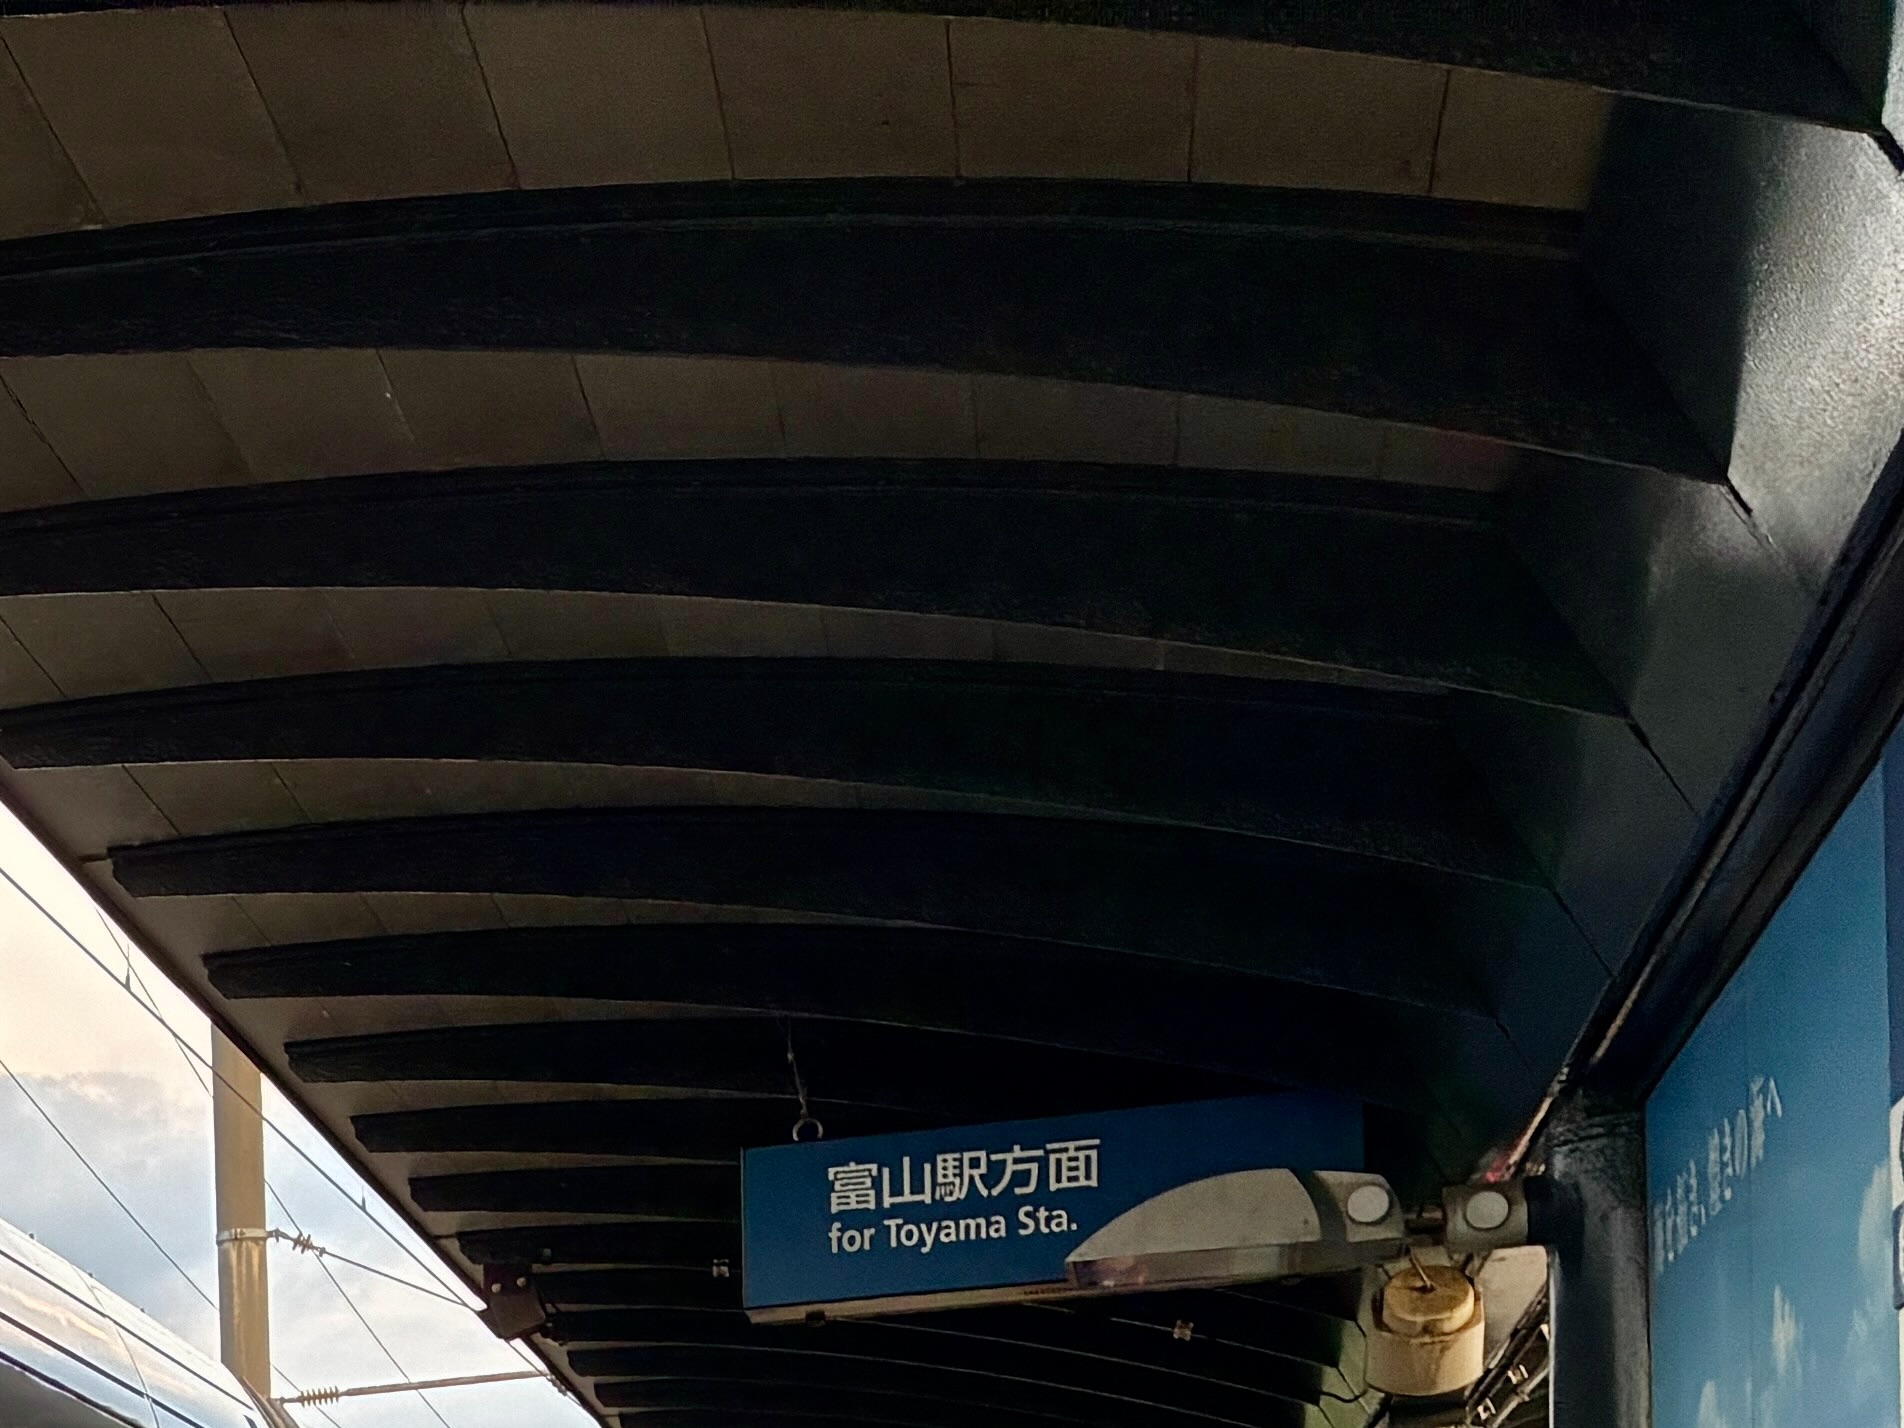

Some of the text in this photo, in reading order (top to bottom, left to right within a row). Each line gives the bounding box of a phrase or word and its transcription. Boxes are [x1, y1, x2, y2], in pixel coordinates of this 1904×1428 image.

[827, 1138, 1101, 1215] 富山駅方面
[828, 1202, 1080, 1255] for Toyama Sta.
